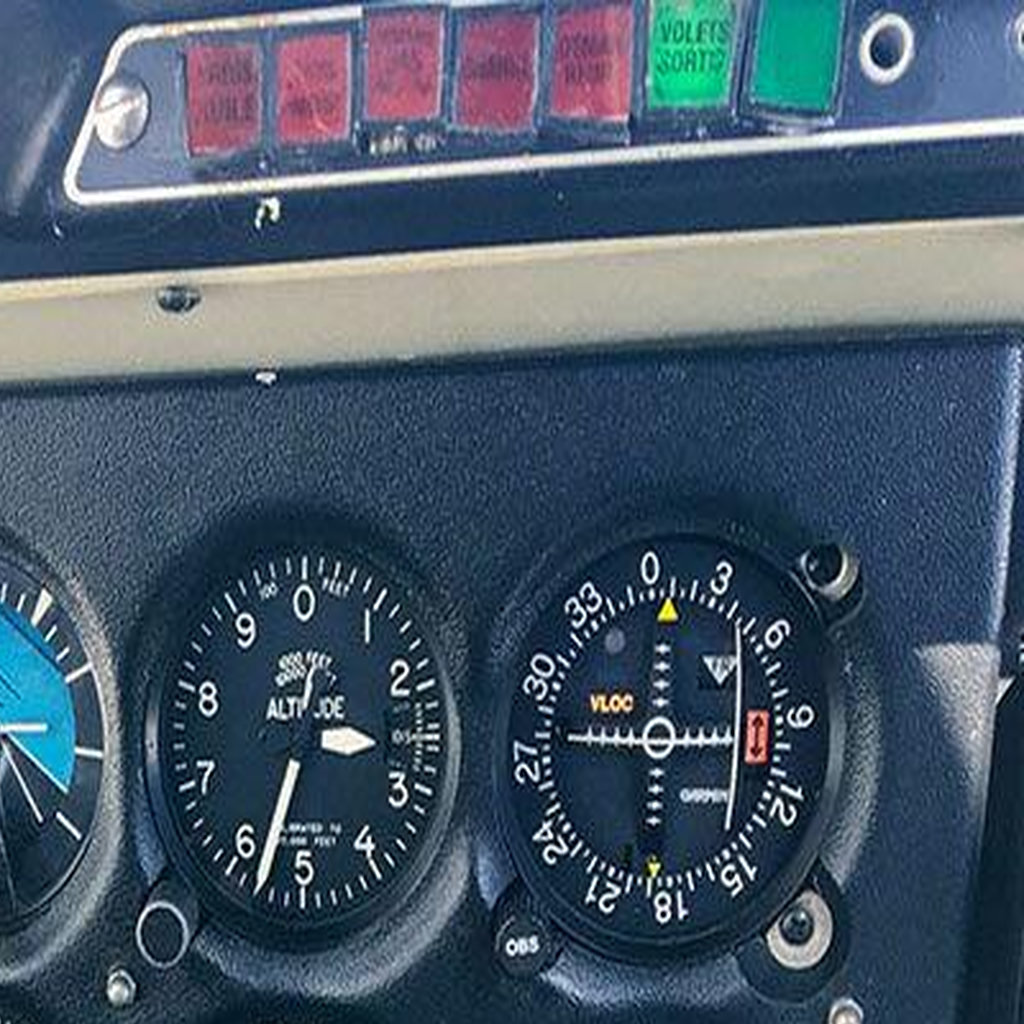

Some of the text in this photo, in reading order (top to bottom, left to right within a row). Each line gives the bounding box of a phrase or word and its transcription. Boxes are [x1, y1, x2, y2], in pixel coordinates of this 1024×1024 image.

[641, 551, 660, 585] 0
[710, 560, 734, 596] 3
[293, 584, 316, 621] 0
[564, 581, 603, 629] 33
[236, 613, 256, 648] 9
[364, 609, 371, 643] 1
[390, 660, 410, 697] 2
[522, 653, 556, 701] 30
[198, 681, 219, 717] 8
[589, 694, 635, 714] VLOC
[196, 761, 216, 795] 7
[513, 740, 540, 785] 27
[388, 772, 409, 808] 3
[769, 783, 805, 828] 12
[236, 824, 255, 859] 6
[353, 825, 375, 858] 4
[532, 820, 569, 866] 24
[294, 850, 314, 886] 5
[719, 854, 758, 897] 15
[585, 875, 622, 914] 21
[653, 892, 689, 924] 18
[504, 935, 540, 956] OBS
